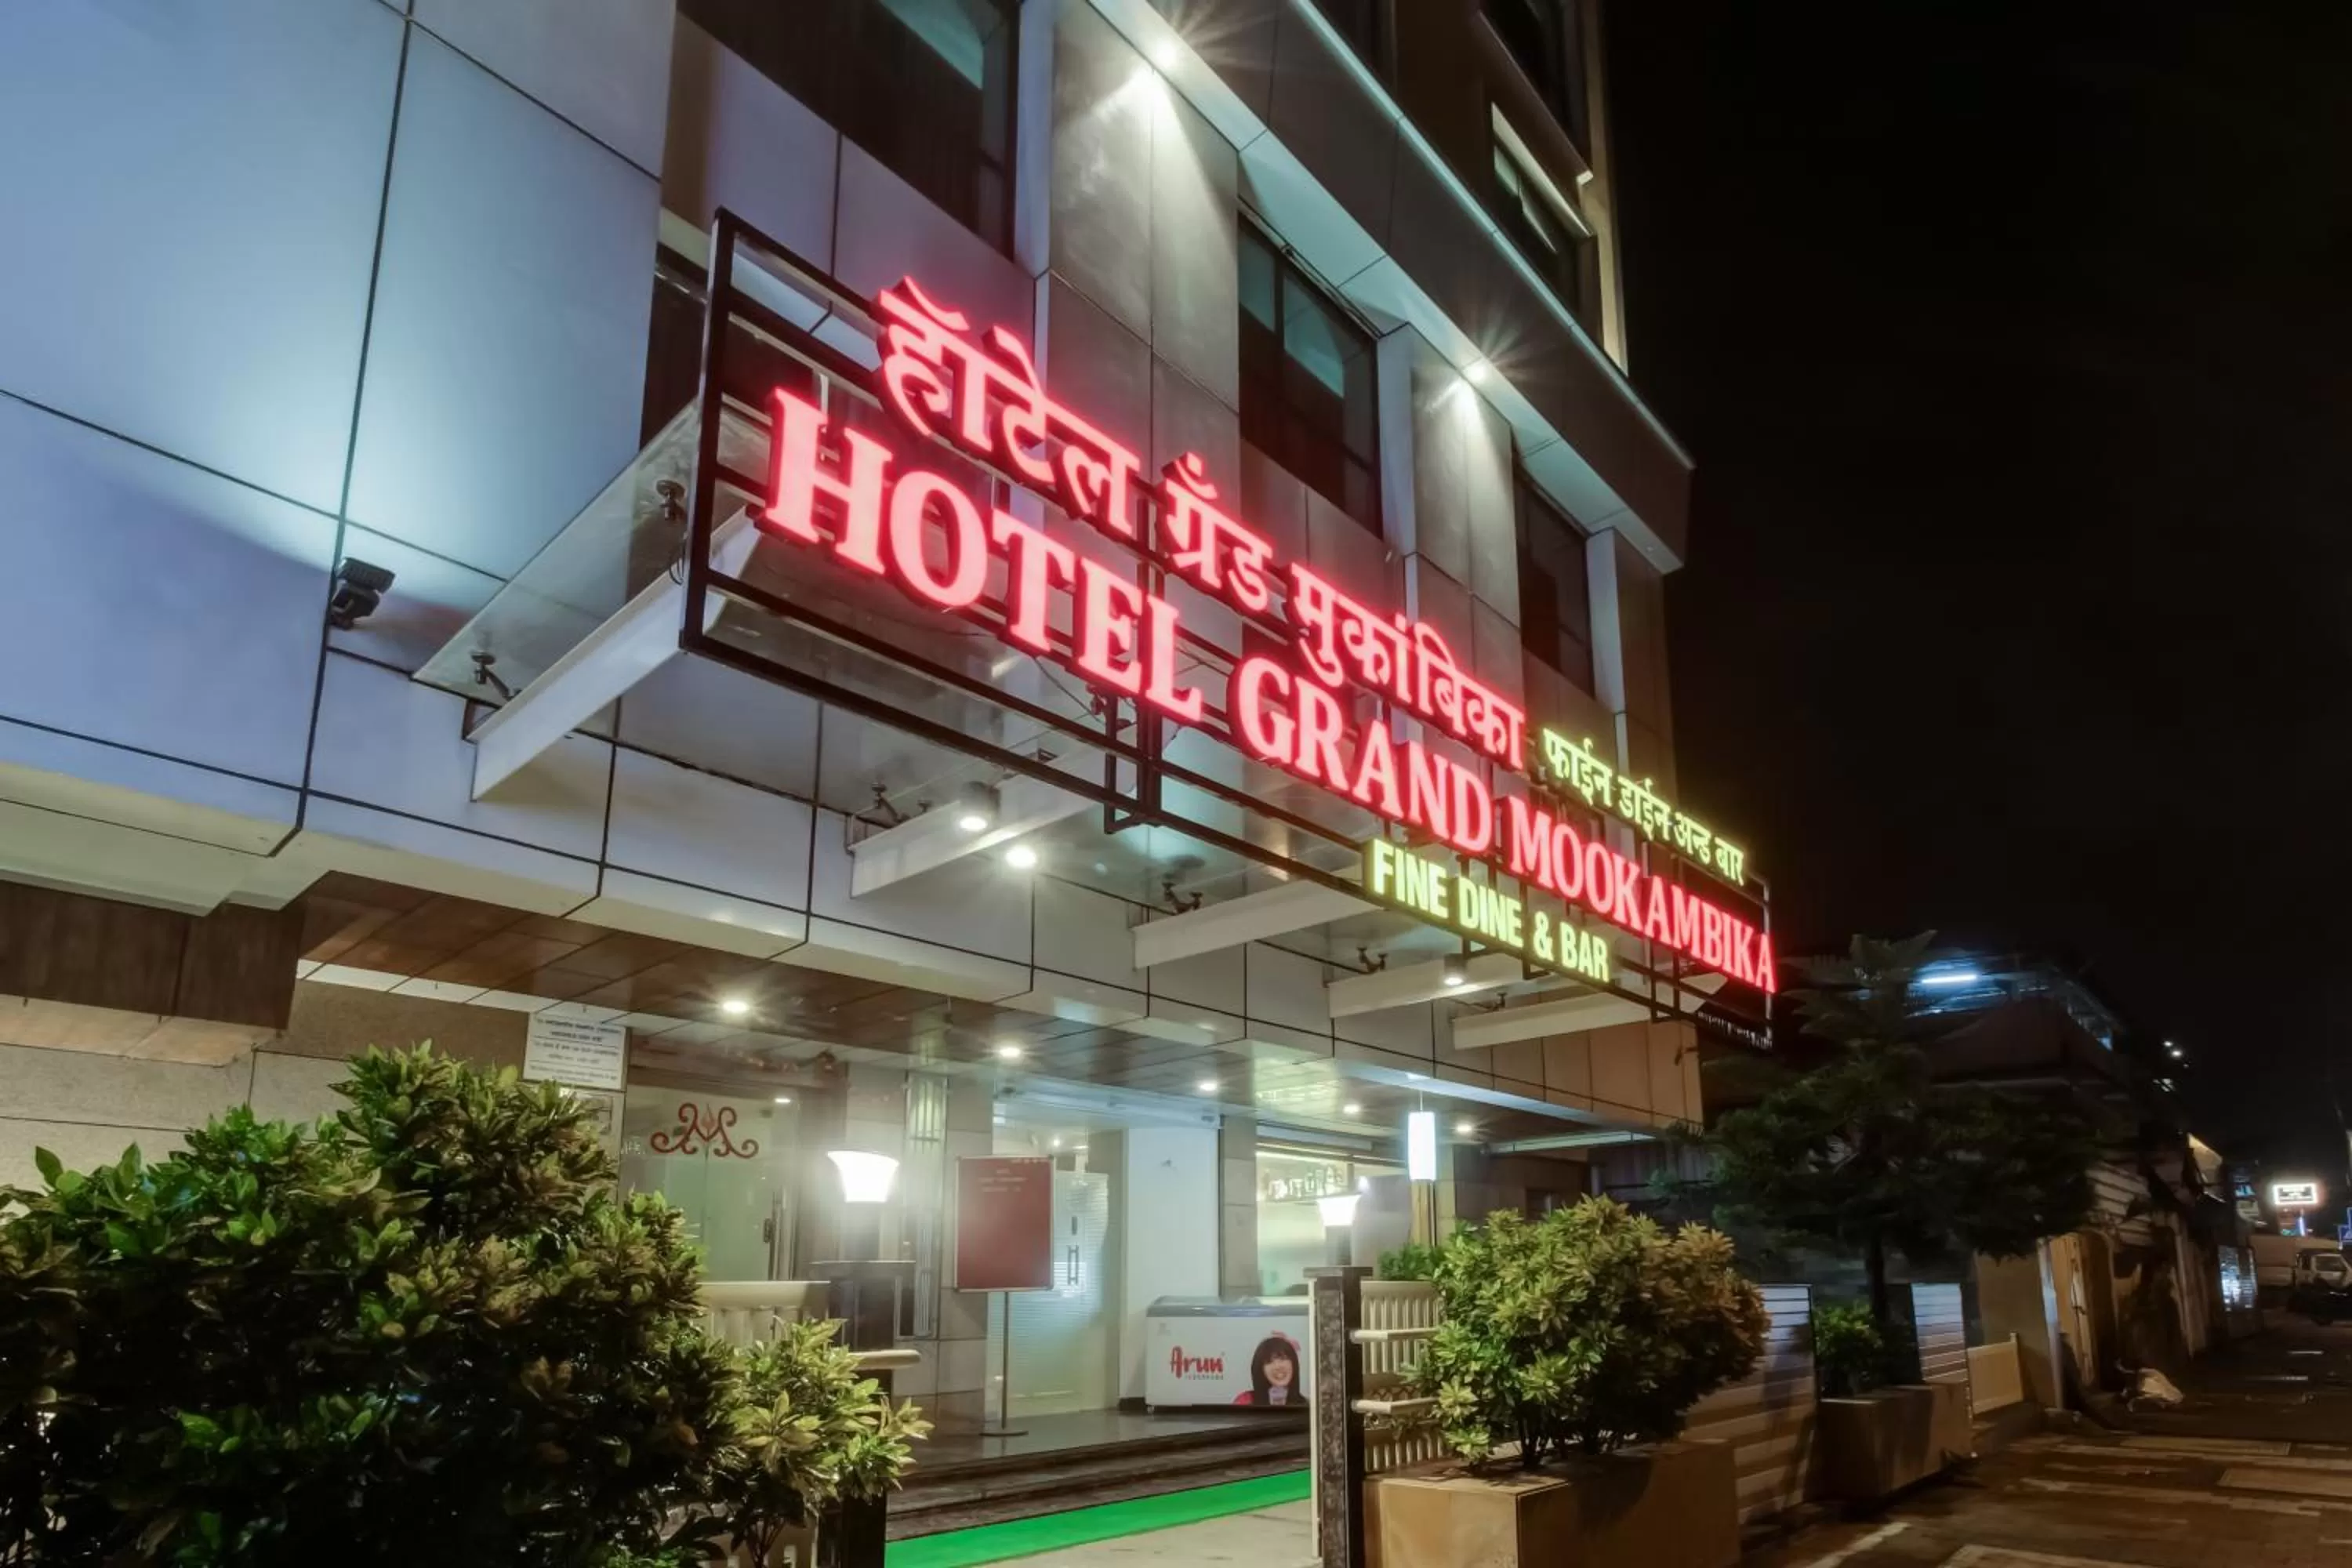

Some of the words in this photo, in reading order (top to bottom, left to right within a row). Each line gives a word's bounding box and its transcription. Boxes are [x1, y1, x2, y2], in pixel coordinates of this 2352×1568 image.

[878, 274, 1141, 536] हॉटेल
[1290, 561, 1525, 769] मुकांबिका
[764, 387, 1204, 721] HOTEL
[1237, 657, 1491, 855] GRAND
[1509, 797, 1777, 993] MOOKAMBIKA
[1542, 727, 1613, 808] फाईन
[1617, 777, 1671, 841] डाईन
[1373, 837, 1450, 920] FINE
[1457, 876, 1524, 948] DINE
[1533, 910, 1554, 962] &
[1559, 920, 1610, 983] BAR
[1170, 1345, 1224, 1379] Arun
